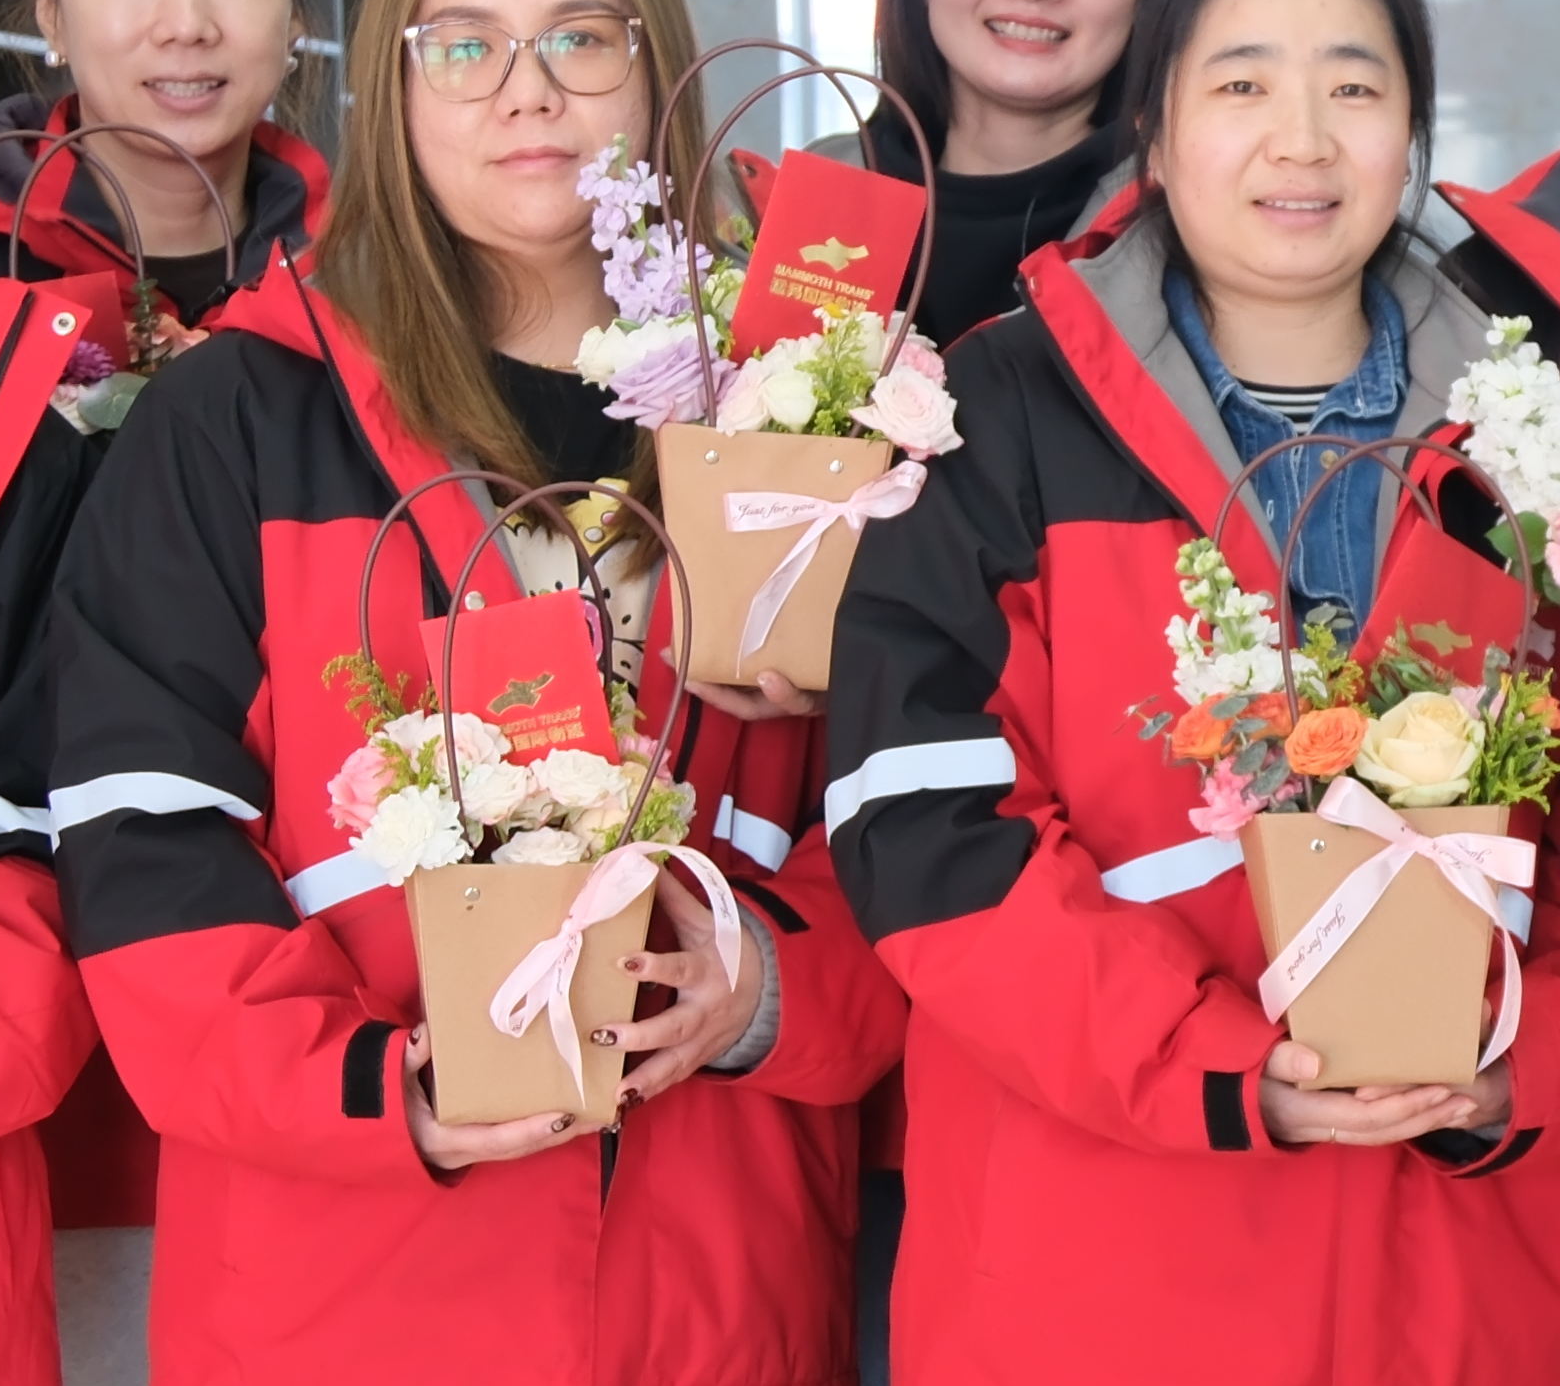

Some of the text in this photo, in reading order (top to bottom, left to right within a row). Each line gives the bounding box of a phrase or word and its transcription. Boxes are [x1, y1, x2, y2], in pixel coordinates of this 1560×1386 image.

[767, 502, 789, 519] for
[511, 720, 585, 753] 国际物流
